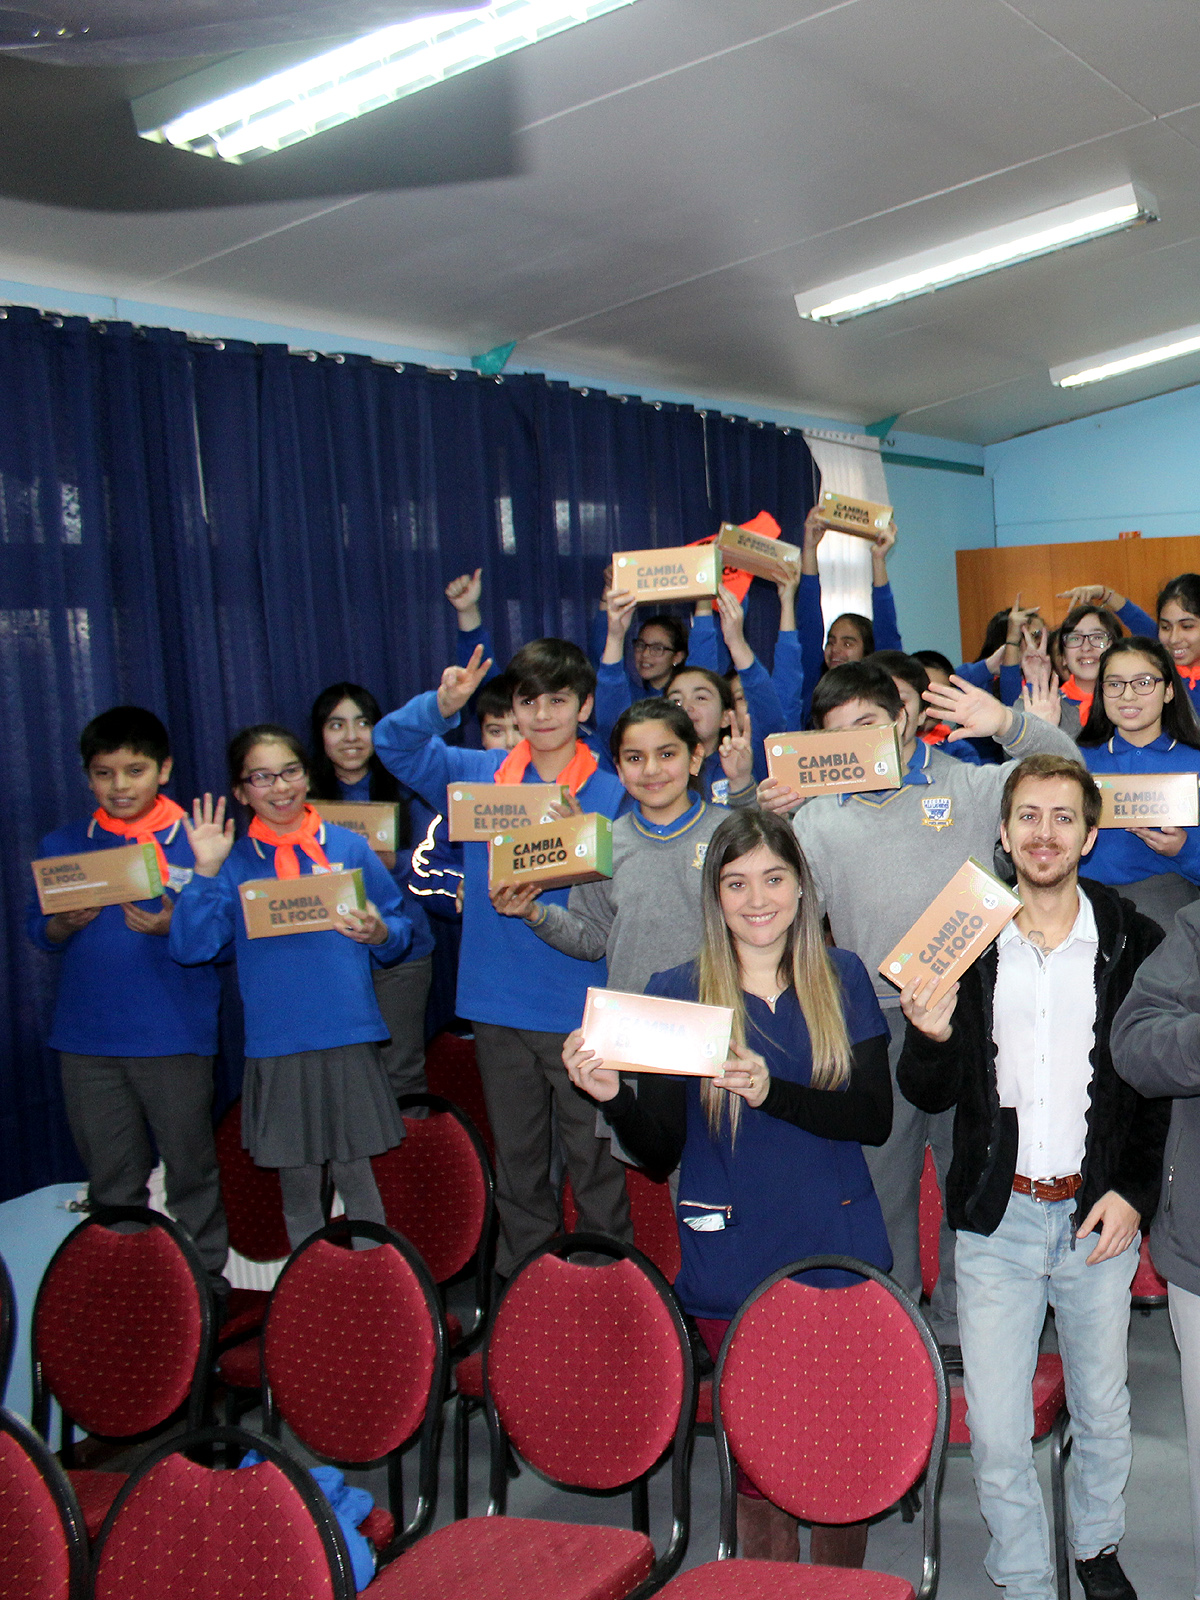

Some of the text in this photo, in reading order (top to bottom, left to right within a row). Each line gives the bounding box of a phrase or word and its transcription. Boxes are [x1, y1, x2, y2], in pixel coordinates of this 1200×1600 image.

[637, 564, 685, 577] CAMBIA
[637, 575, 688, 589] EL FOCO
[798, 752, 859, 769] CAMBIA
[800, 771, 816, 784] EL
[820, 766, 865, 782] FOCO
[1114, 791, 1166, 802] CAMBIA
[474, 804, 527, 816] CAMBIA
[1114, 804, 1170, 815] EL FOCO
[474, 818, 488, 829] EL
[513, 836, 564, 856] CAMBIA
[513, 859, 526, 870] EL
[529, 849, 567, 867] FOCO
[268, 895, 323, 911] CAMBIA
[270, 913, 286, 925] EL
[288, 907, 328, 922] FOCO
[919, 910, 969, 964] CAMBIA
[930, 958, 950, 976] EL
[944, 915, 983, 959] FOCO
